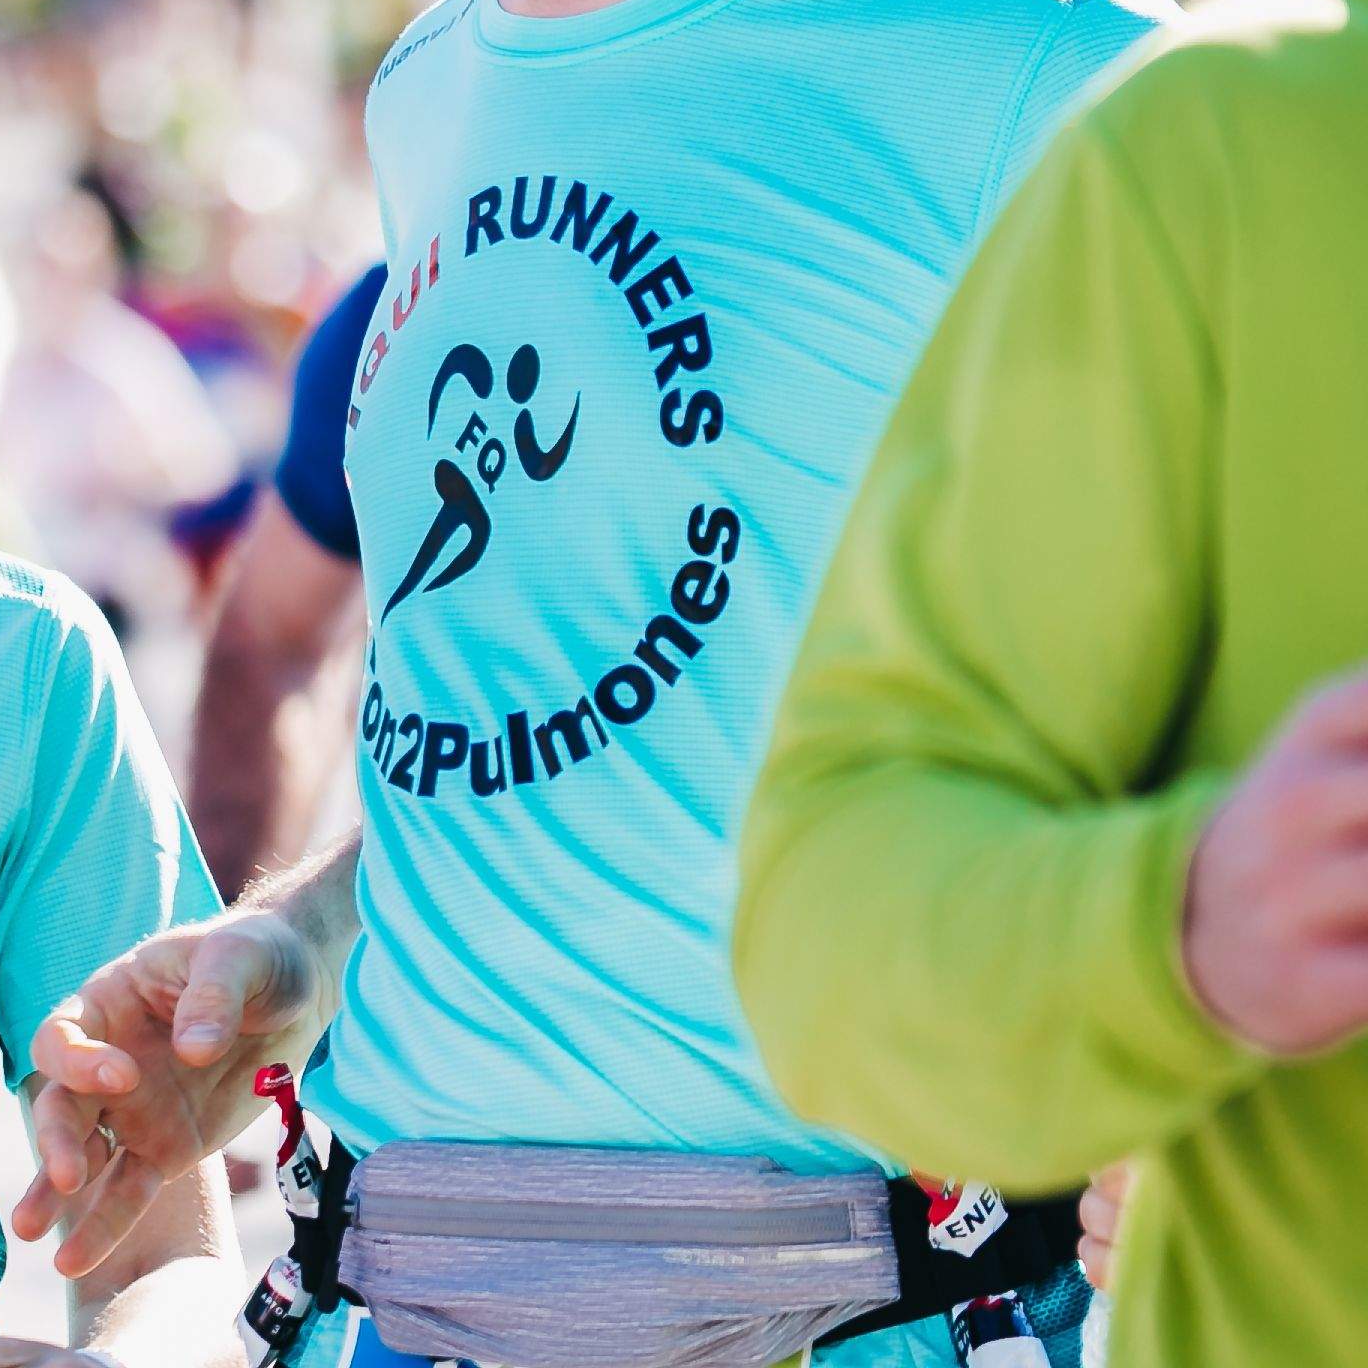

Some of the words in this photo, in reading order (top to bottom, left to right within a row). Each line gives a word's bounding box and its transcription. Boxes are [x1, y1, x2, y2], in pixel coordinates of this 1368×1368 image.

[464, 175, 725, 449] RUNNERS
[455, 410, 507, 494] FQ
[944, 1185, 1003, 1239] ENE
